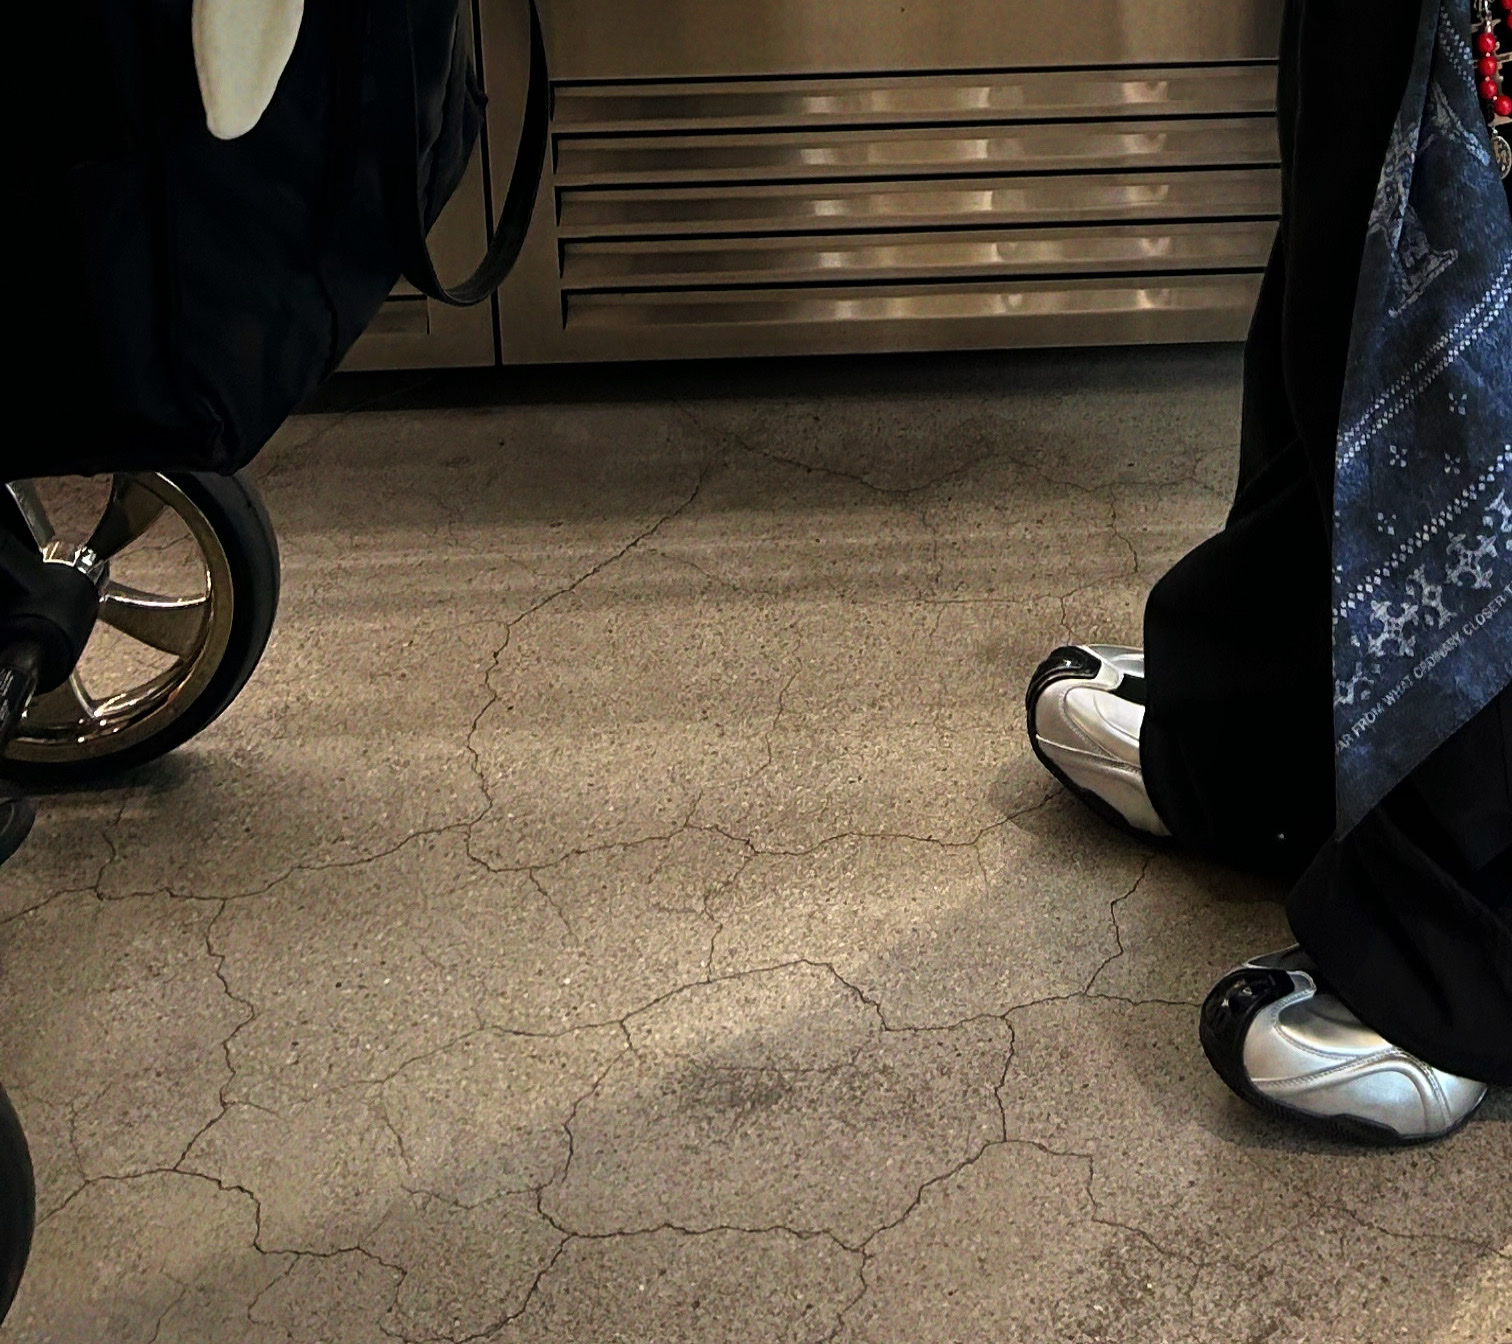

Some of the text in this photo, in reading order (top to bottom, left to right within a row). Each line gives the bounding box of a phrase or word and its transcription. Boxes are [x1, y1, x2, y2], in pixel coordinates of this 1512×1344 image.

[1335, 733, 1355, 753] AR
[1351, 703, 1385, 738] FROM
[1381, 676, 1415, 708] WHAT
[1461, 595, 1508, 637] CLOSER
